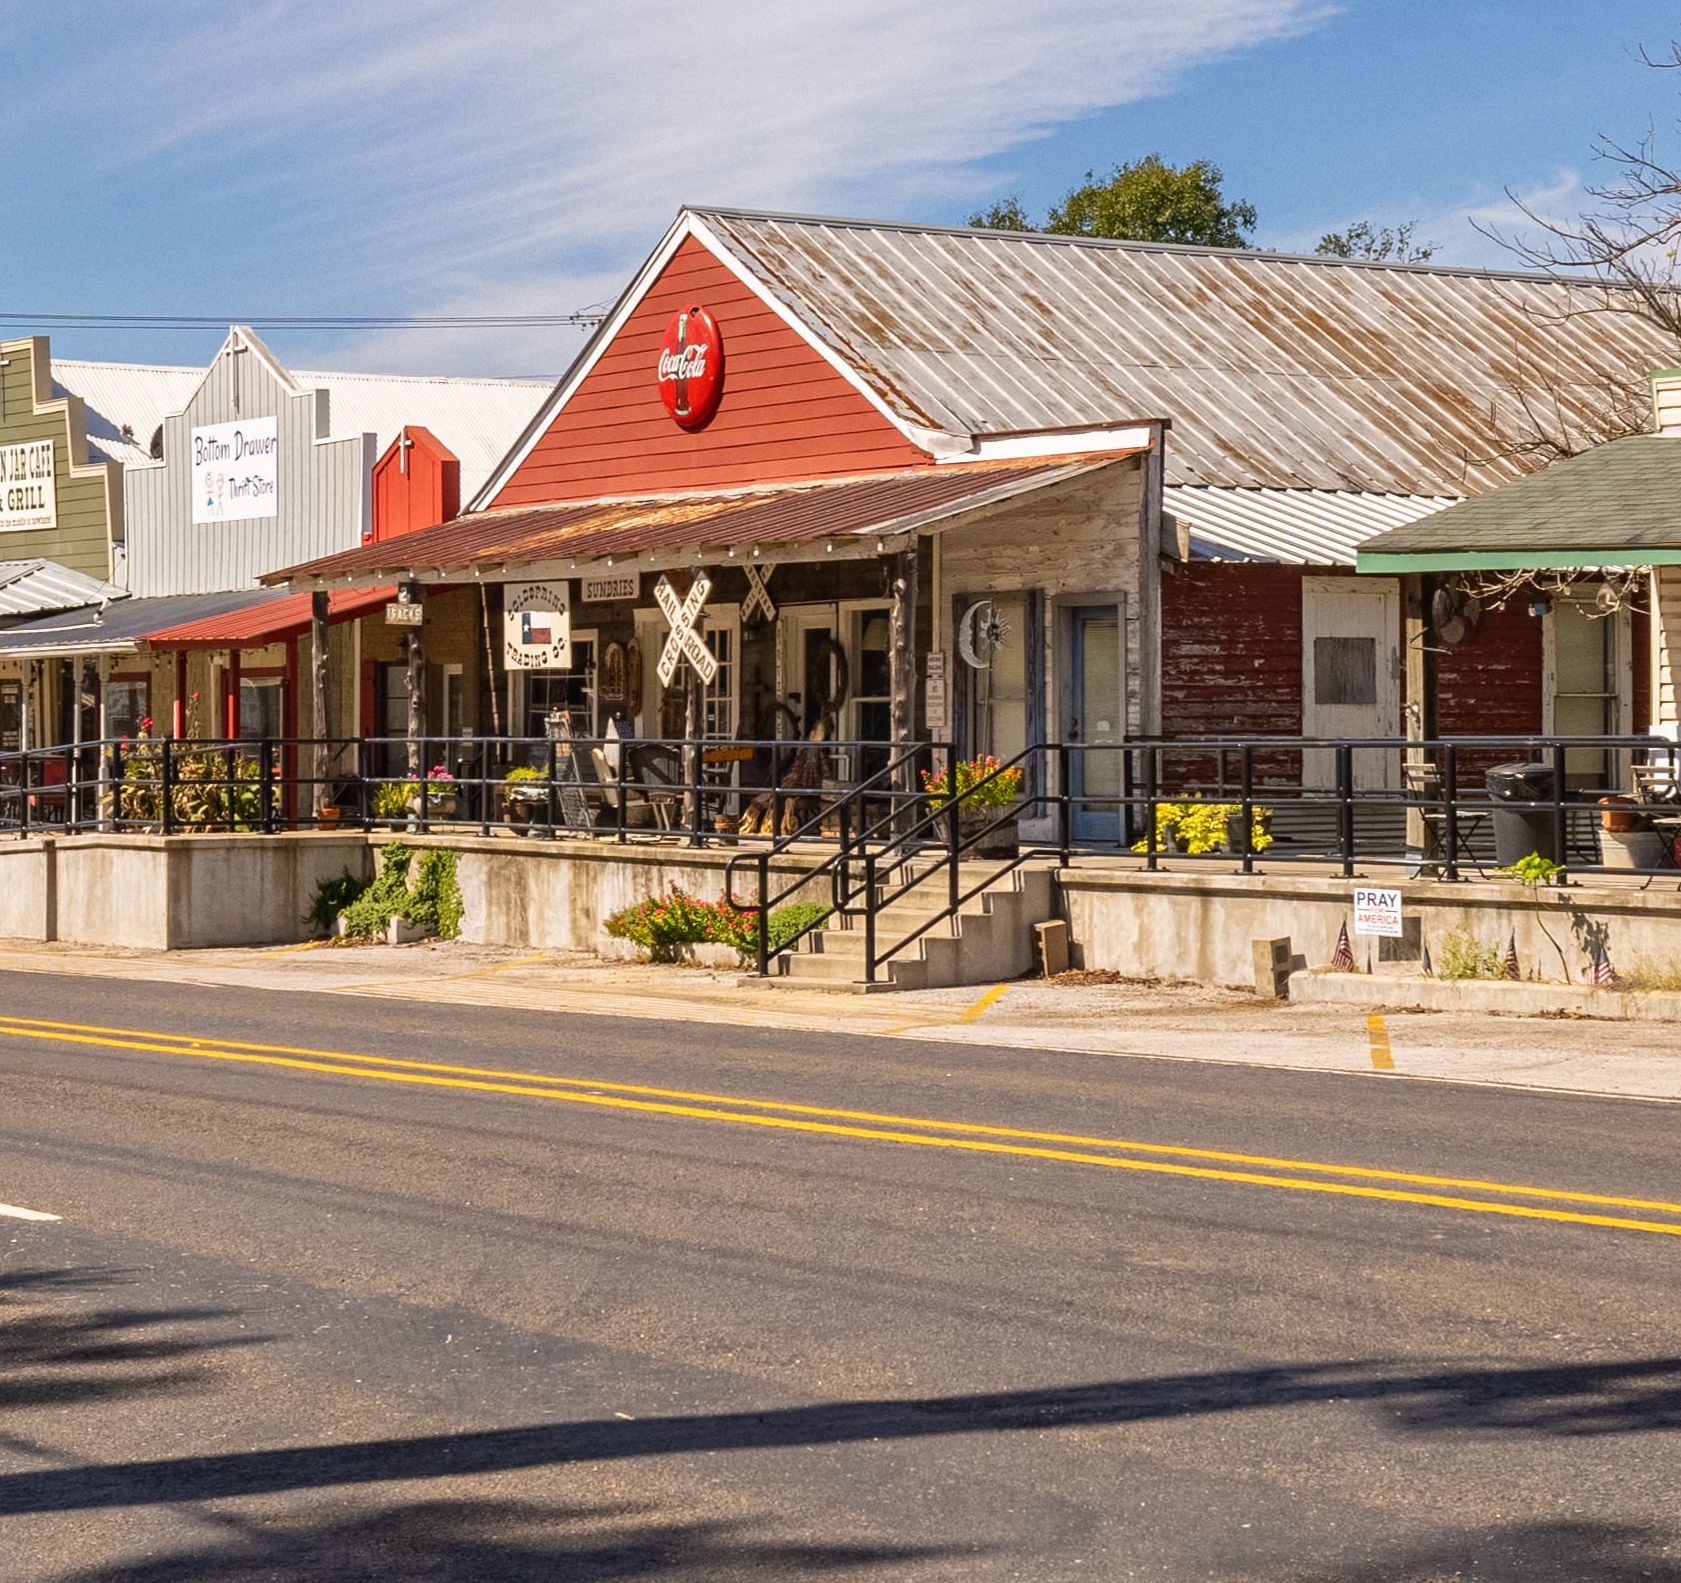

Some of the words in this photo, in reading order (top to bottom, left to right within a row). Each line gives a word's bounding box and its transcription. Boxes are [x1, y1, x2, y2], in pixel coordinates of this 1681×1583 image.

[195, 436, 230, 466] Bottom
[234, 430, 276, 461] Drawer
[10, 448, 27, 482] JAR
[30, 444, 51, 479] CAFE
[8, 485, 45, 511] GRILL
[229, 477, 251, 499] Thrift
[253, 475, 274, 497] Store
[399, 587, 407, 602] 2
[587, 579, 634, 599] SUNDRIES
[508, 586, 566, 621] COLDSPRING
[657, 585, 676, 622] RAIL
[684, 635, 714, 680] ROAD
[660, 581, 705, 678] CROSSING
[507, 642, 548, 667] TRADING
[1357, 892, 1397, 907] PRAY
[1358, 914, 1398, 925] AMERICA
